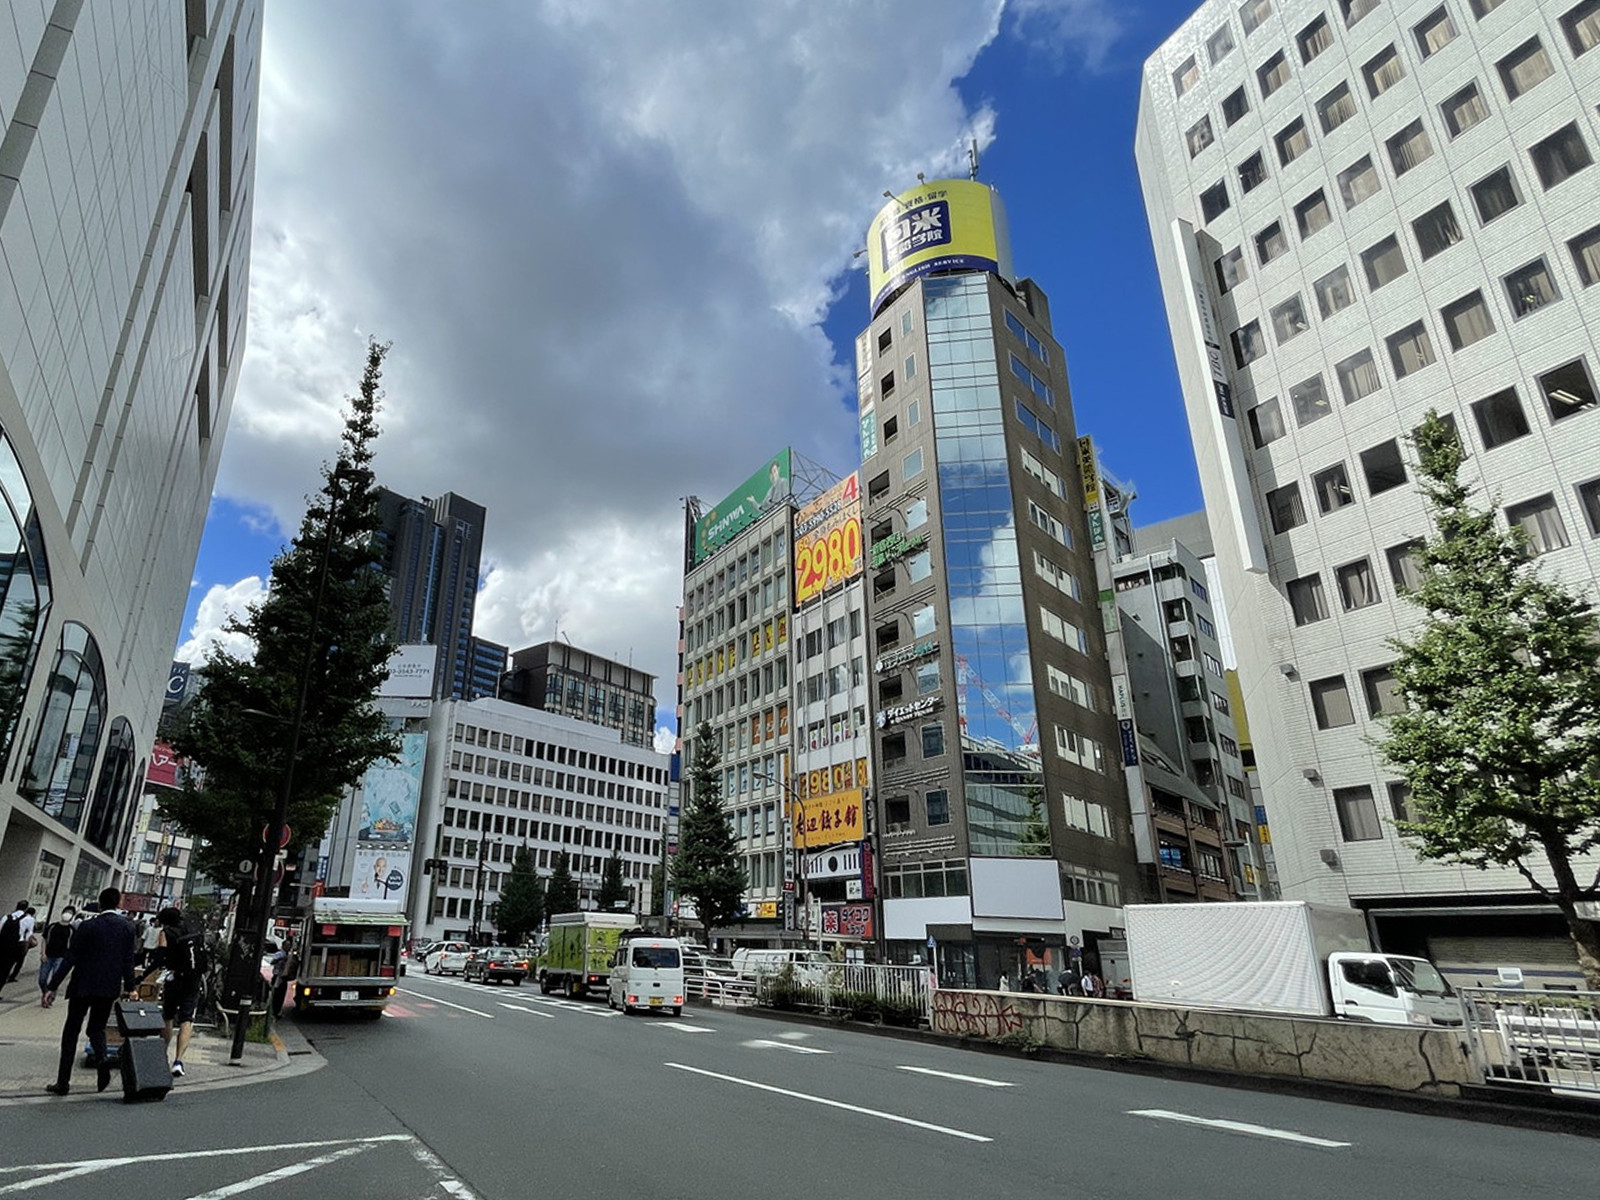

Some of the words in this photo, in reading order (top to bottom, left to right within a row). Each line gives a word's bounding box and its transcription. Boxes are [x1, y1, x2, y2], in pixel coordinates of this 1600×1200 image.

[843, 475, 858, 500] 4
[797, 518, 861, 602] 2980
[887, 697, 940, 719] ダイエットセンター
[823, 910, 838, 933] 薬
